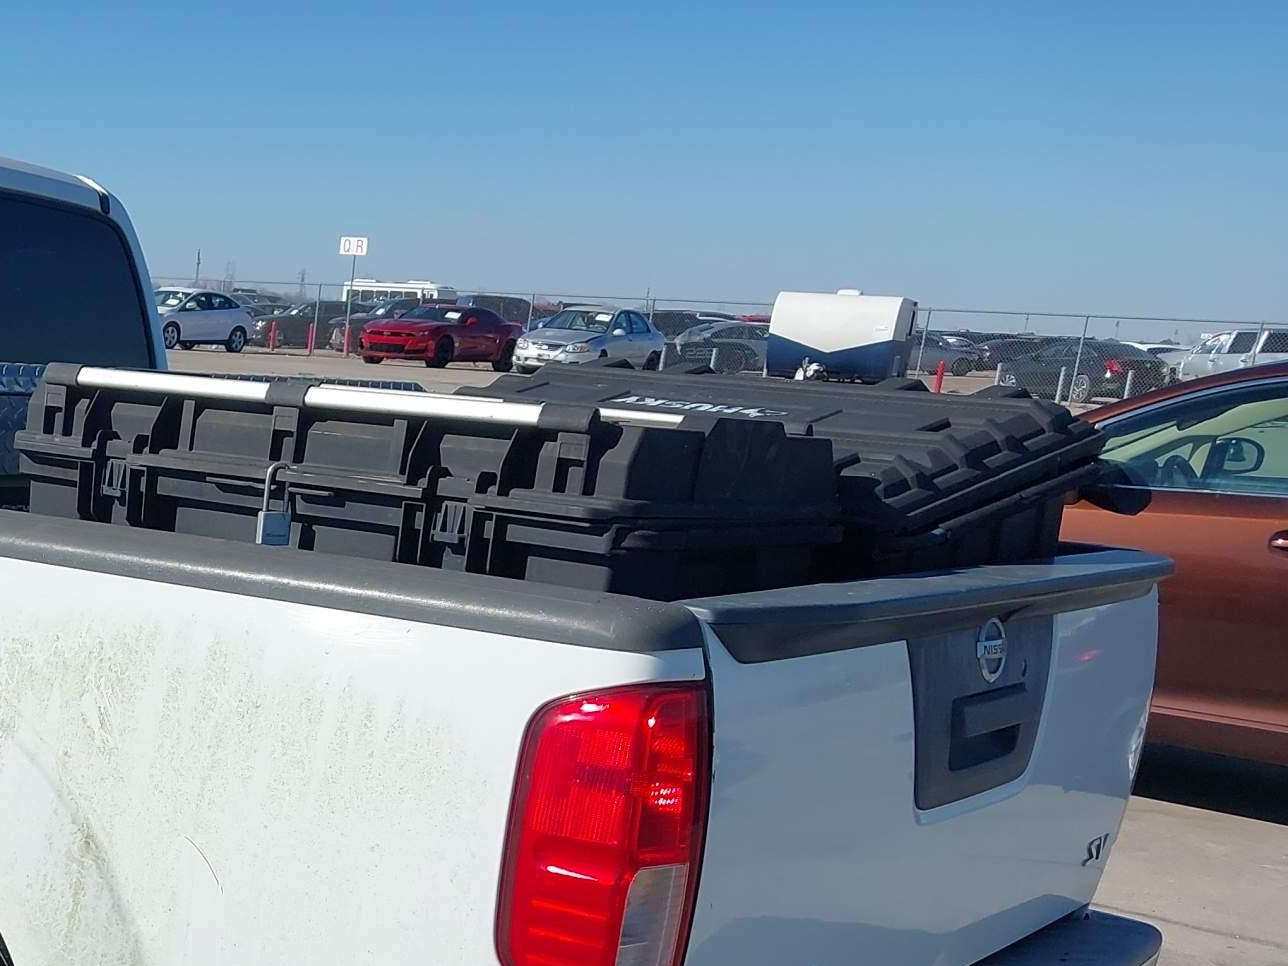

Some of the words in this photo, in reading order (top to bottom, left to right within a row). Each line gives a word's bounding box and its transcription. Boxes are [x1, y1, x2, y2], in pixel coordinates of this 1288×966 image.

[343, 238, 351, 253] Q
[356, 239, 364, 254] R
[610, 395, 743, 414] HUSKY
